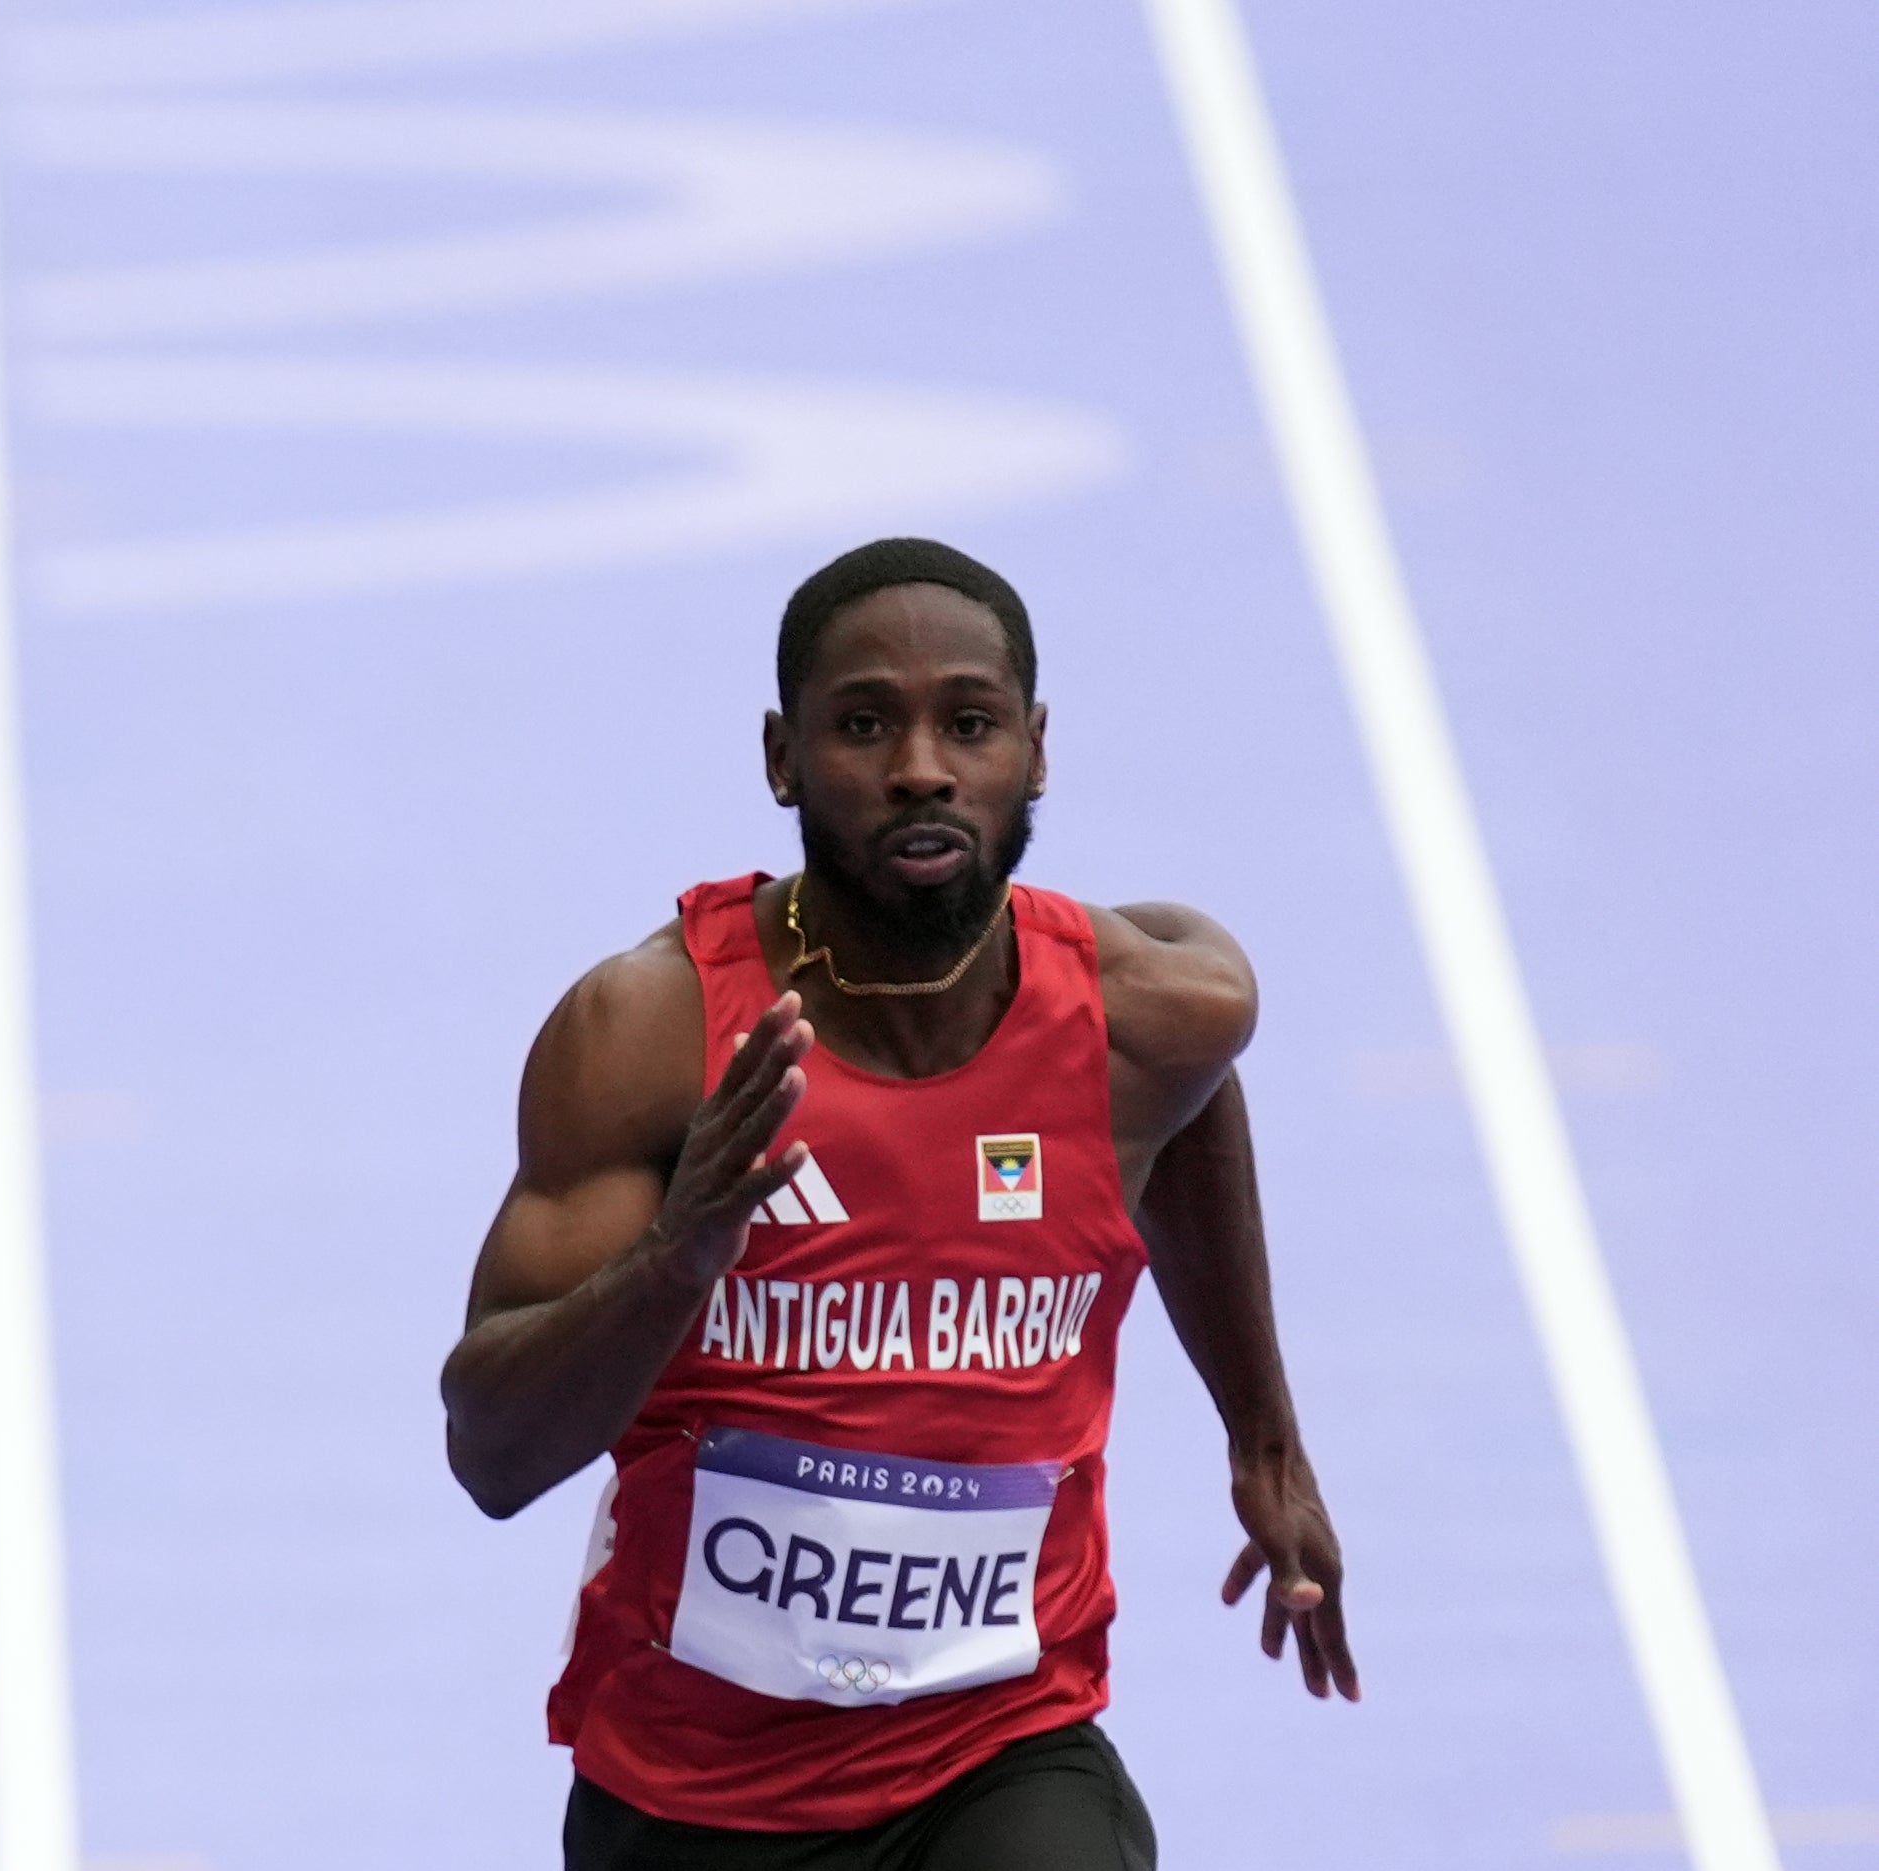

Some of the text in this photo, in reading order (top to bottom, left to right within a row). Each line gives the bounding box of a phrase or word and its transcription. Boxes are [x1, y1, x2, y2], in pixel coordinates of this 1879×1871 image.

[701, 1271, 1102, 1371] ANTIGUA BARBUD
[900, 1470, 981, 1500] 2024
[701, 1515, 1028, 1631] GREENE
